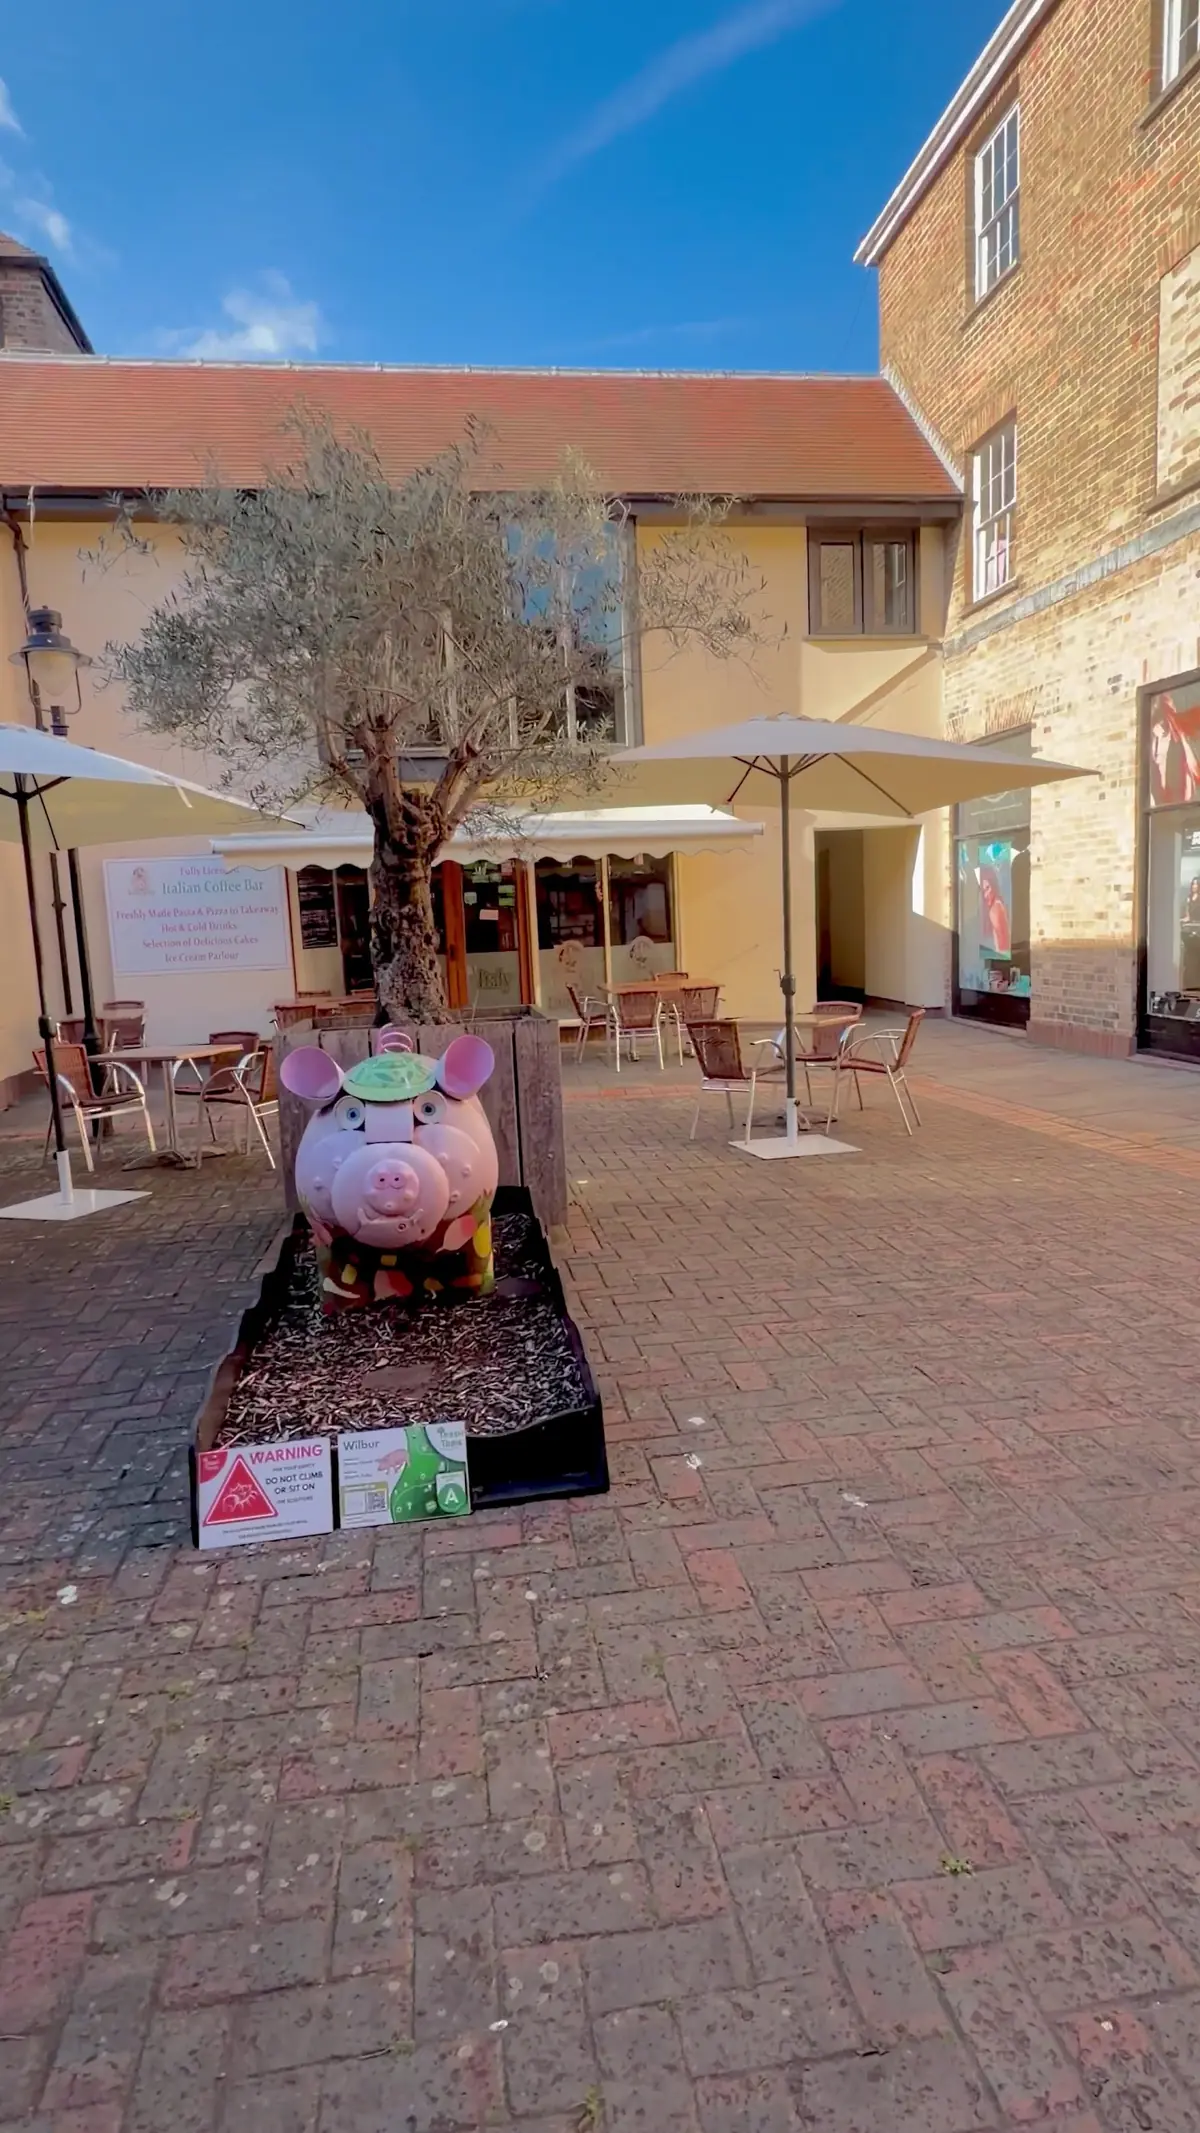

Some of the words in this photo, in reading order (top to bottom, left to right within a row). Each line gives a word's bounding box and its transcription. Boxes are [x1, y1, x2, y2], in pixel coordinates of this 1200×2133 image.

[162, 881, 201, 894] Italian
[204, 880, 241, 893] Coffee
[244, 879, 263, 891] Bar
[116, 908, 146, 921] Freshly
[148, 908, 172, 918] Made
[173, 907, 196, 917] Pasta
[206, 907, 228, 916] Pizza
[240, 905, 278, 915] Takeaway
[161, 923, 177, 933] Hot
[187, 921, 207, 932] Cold
[209, 920, 237, 931] Drinks
[142, 938, 181, 949] Selection
[182, 938, 191, 947] of
[193, 936, 232, 947] Delicious
[234, 935, 259, 944] Cakes
[165, 953, 177, 963] Ice
[179, 952, 206, 962] Cream
[208, 951, 239, 961] Parlour
[343, 1440, 380, 1451] Wilbur
[250, 1444, 323, 1464] WARNING
[265, 1477, 278, 1485] DO
[280, 1474, 297, 1483] NOT
[299, 1471, 323, 1481] CLIMB
[274, 1486, 286, 1494] OR
[289, 1484, 301, 1492] SIT
[302, 1482, 315, 1491] ON
[445, 1488, 459, 1504] A
